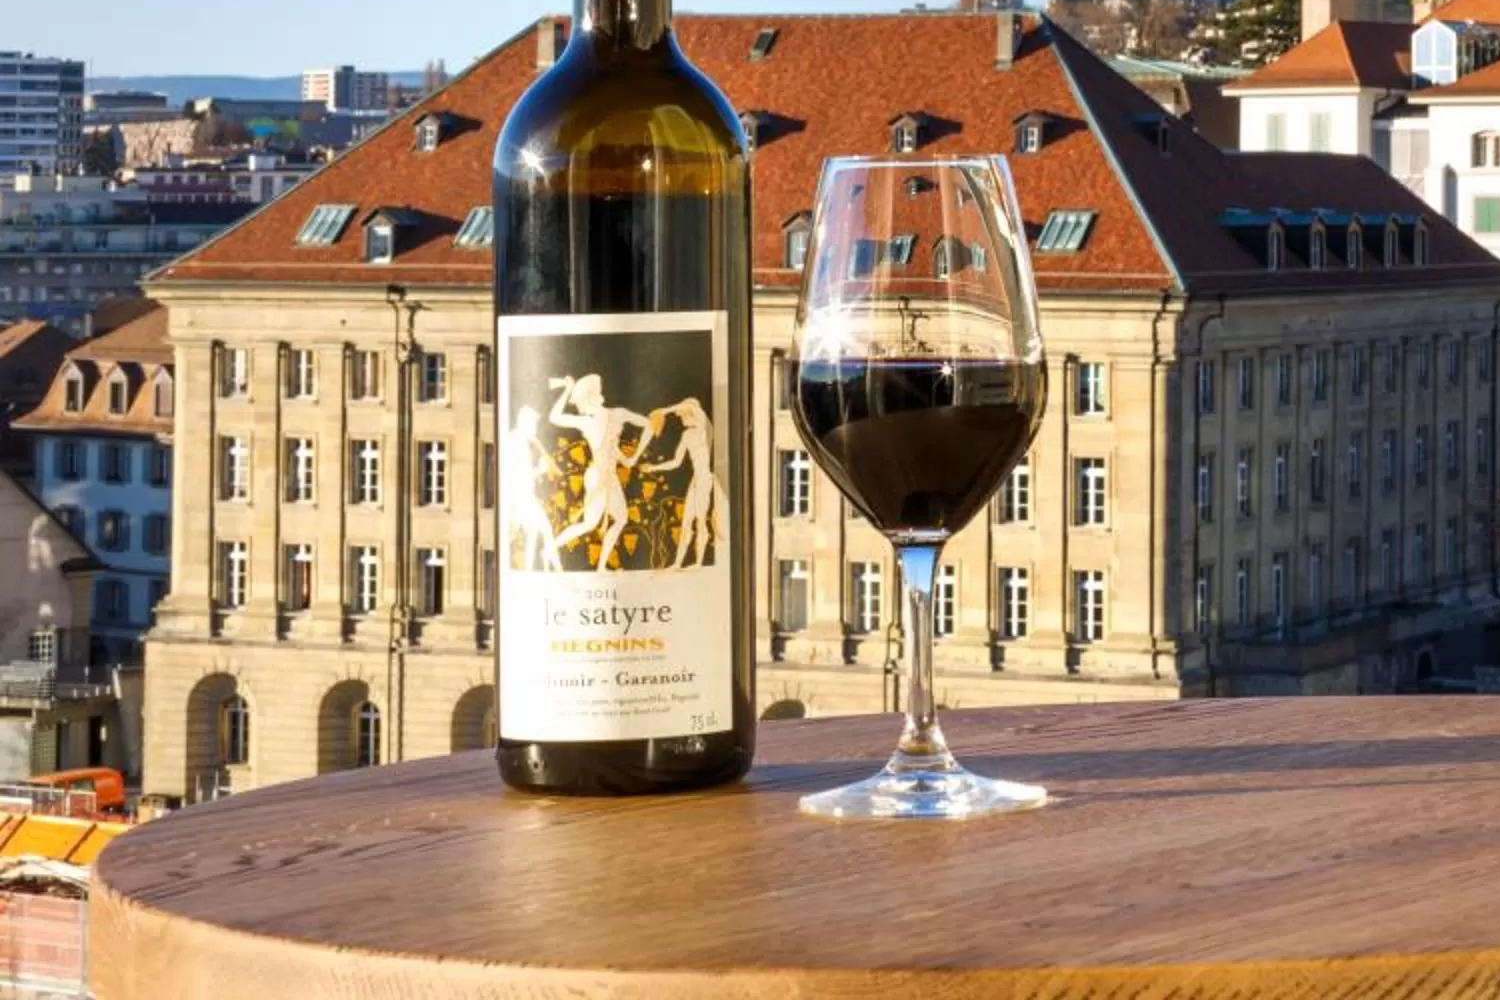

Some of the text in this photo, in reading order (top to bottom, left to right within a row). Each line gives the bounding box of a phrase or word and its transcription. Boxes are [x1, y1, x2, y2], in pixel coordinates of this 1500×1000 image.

[544, 598, 673, 635] le satyre
[615, 667, 697, 686] Garanoir
